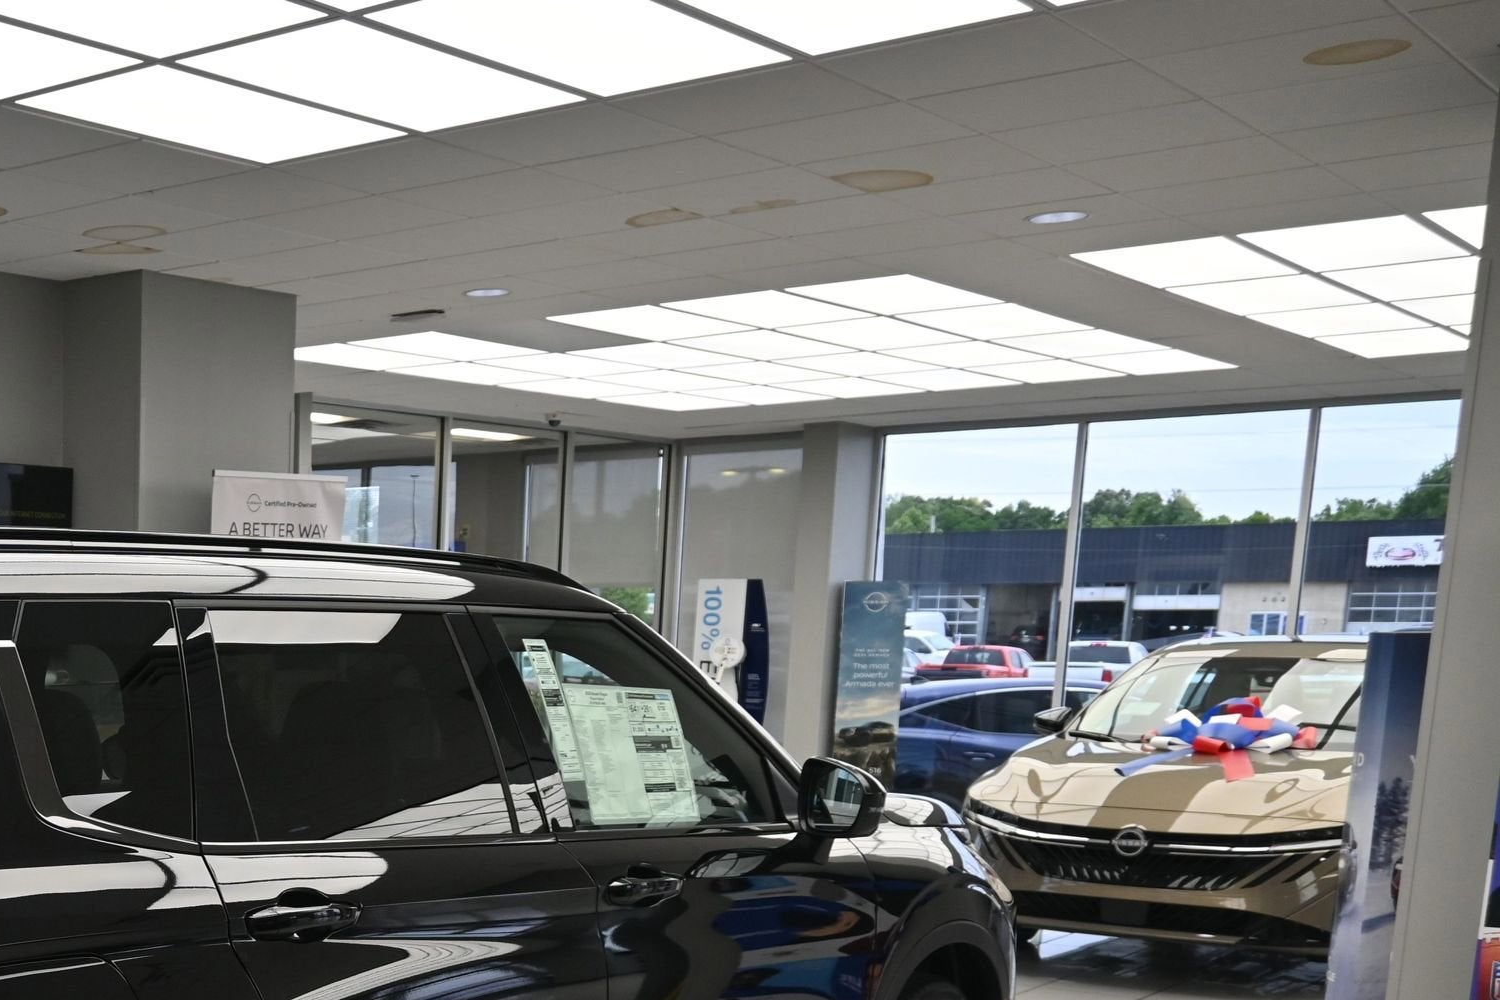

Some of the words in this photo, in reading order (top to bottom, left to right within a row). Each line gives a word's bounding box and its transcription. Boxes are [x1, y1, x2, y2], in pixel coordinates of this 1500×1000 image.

[229, 521, 238, 536] A
[242, 522, 295, 538] BETTER
[298, 524, 328, 539] WAY
[701, 586, 723, 650] 100%
